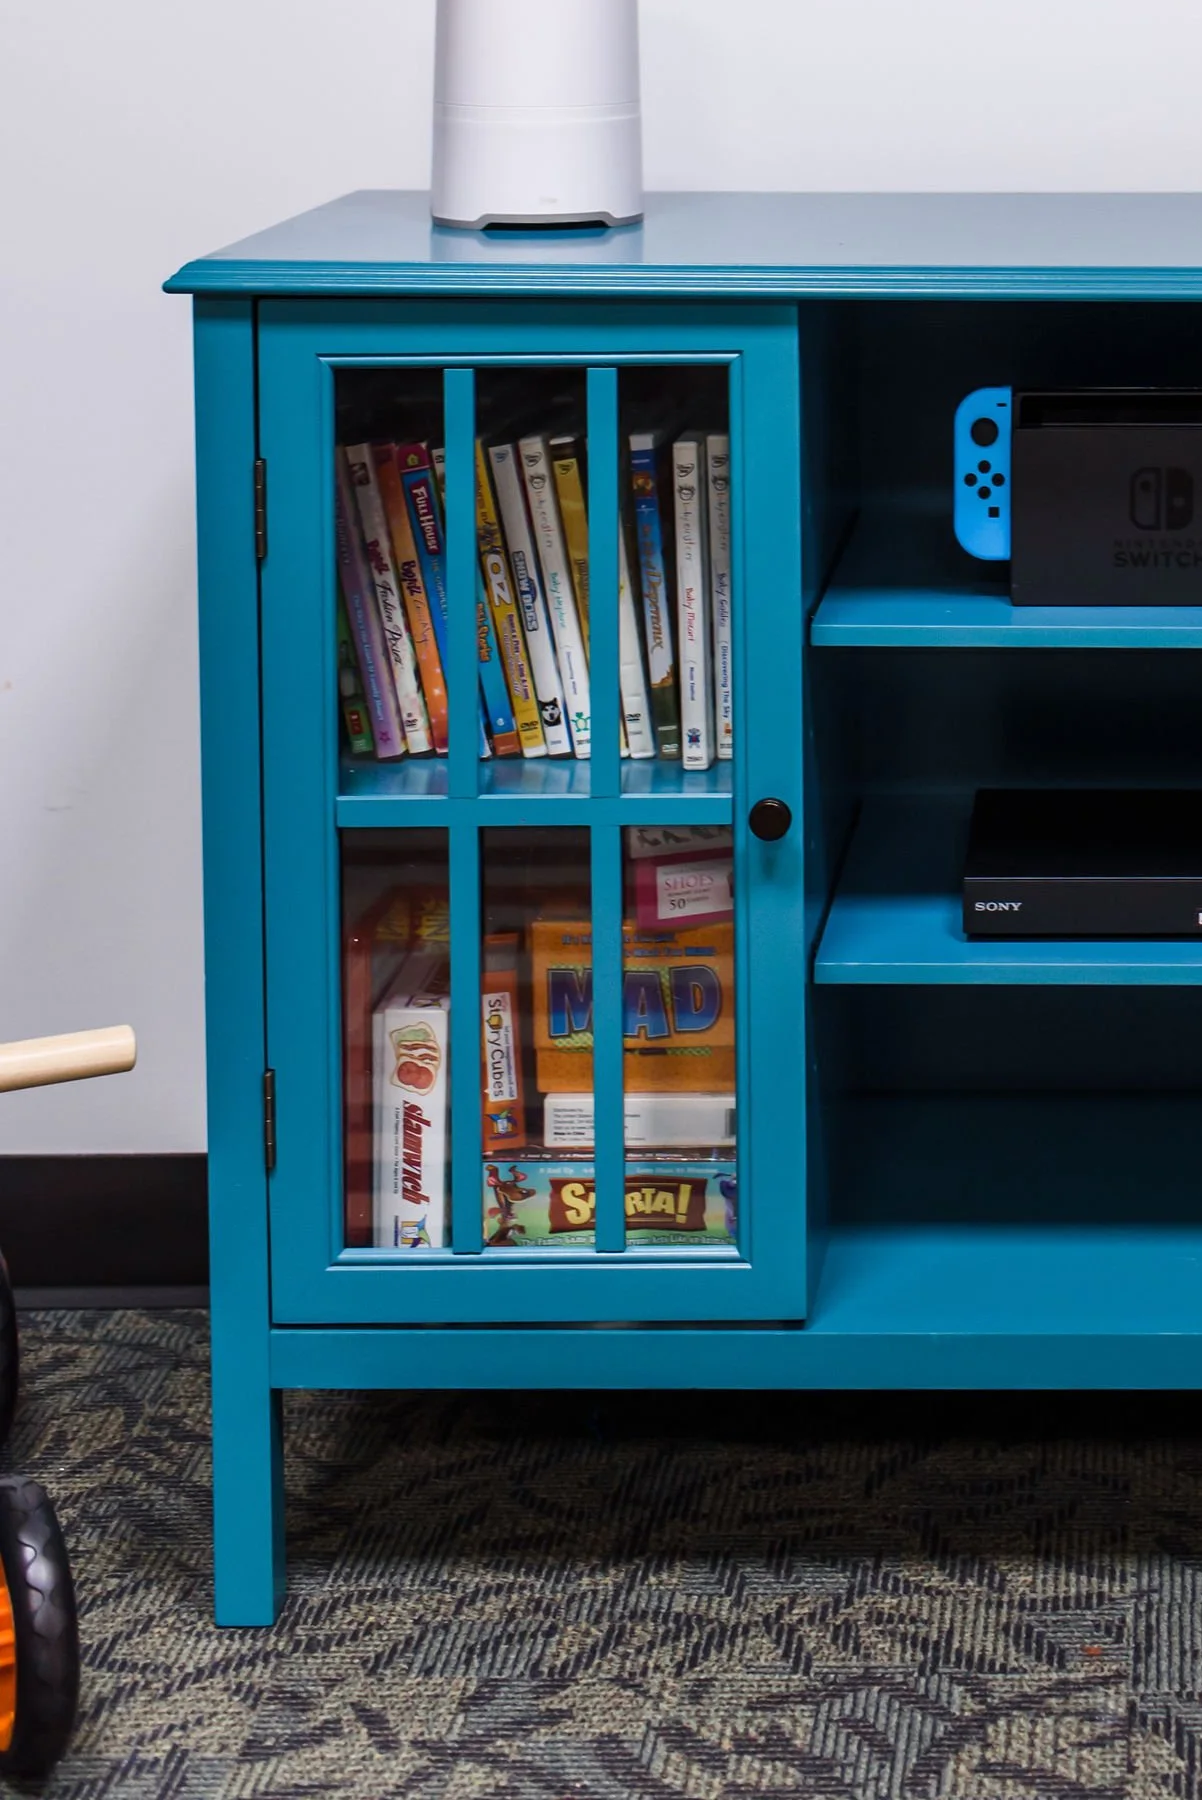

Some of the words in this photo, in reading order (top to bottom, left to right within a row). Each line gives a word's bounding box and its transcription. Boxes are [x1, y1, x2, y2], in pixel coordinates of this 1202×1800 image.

[411, 486, 429, 515] FULL
[420, 514, 439, 551] HOUSE
[521, 593, 539, 632] DOGS
[663, 874, 714, 891] SHOES
[669, 898, 686, 911] 50
[975, 902, 1022, 911] SONY
[547, 964, 722, 1039] MAD
[561, 1183, 692, 1224] SRTA!
